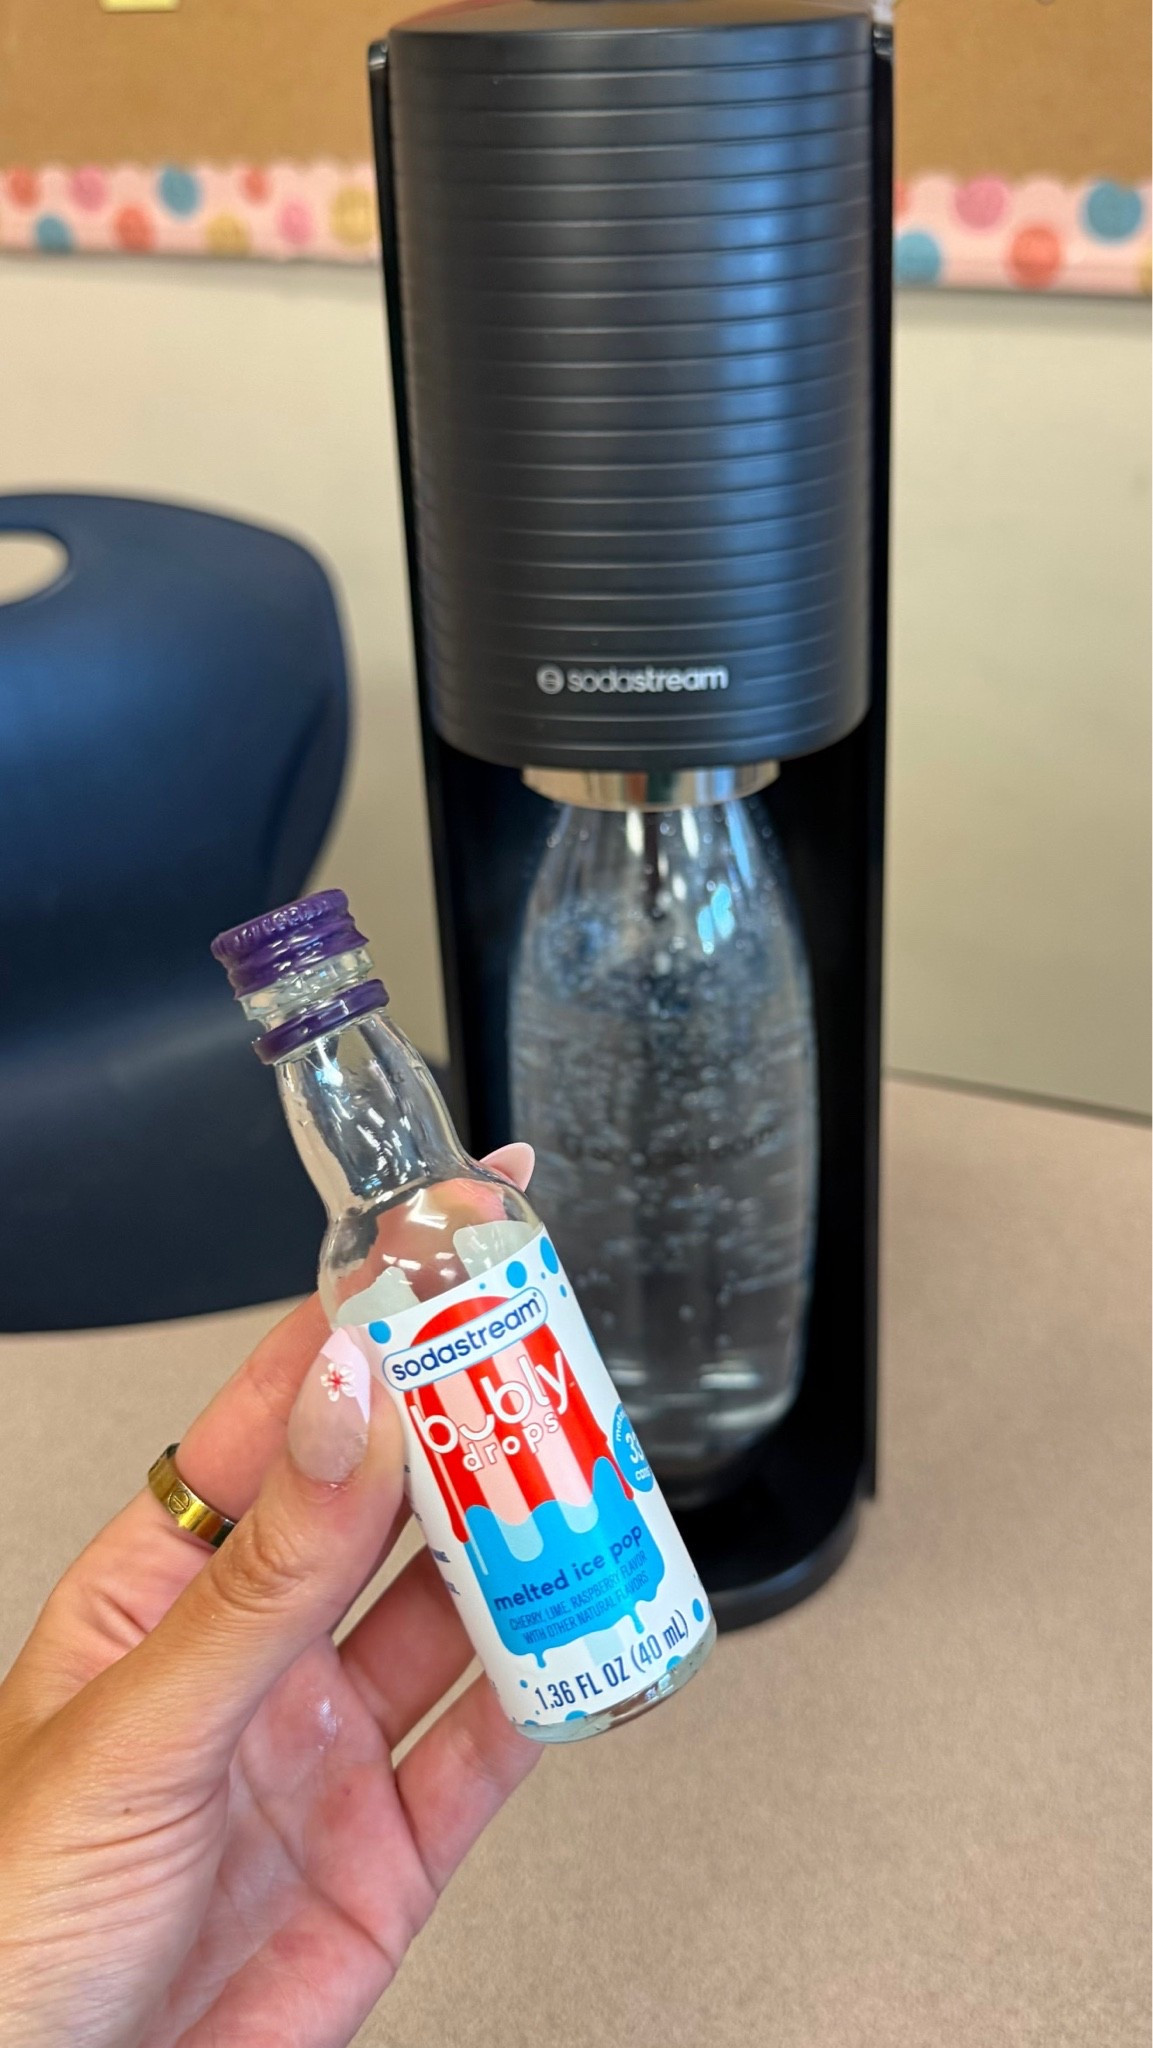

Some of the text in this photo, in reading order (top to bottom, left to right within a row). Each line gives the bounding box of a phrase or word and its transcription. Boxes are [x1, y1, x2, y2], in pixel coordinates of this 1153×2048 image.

[567, 667, 729, 693] sodastream
[392, 1296, 541, 1381] sodastream
[410, 1350, 568, 1454] bubly
[462, 1412, 560, 1472] drops
[493, 1525, 642, 1611] melted ice pop
[509, 1551, 648, 1631] CHERRY, LIME, RASPBERRY FLAVOR
[523, 1571, 649, 1644] WITH OTHER NATURAL FLAVORS
[535, 1609, 689, 1710] 1.36 FL OZ (40 mL)
